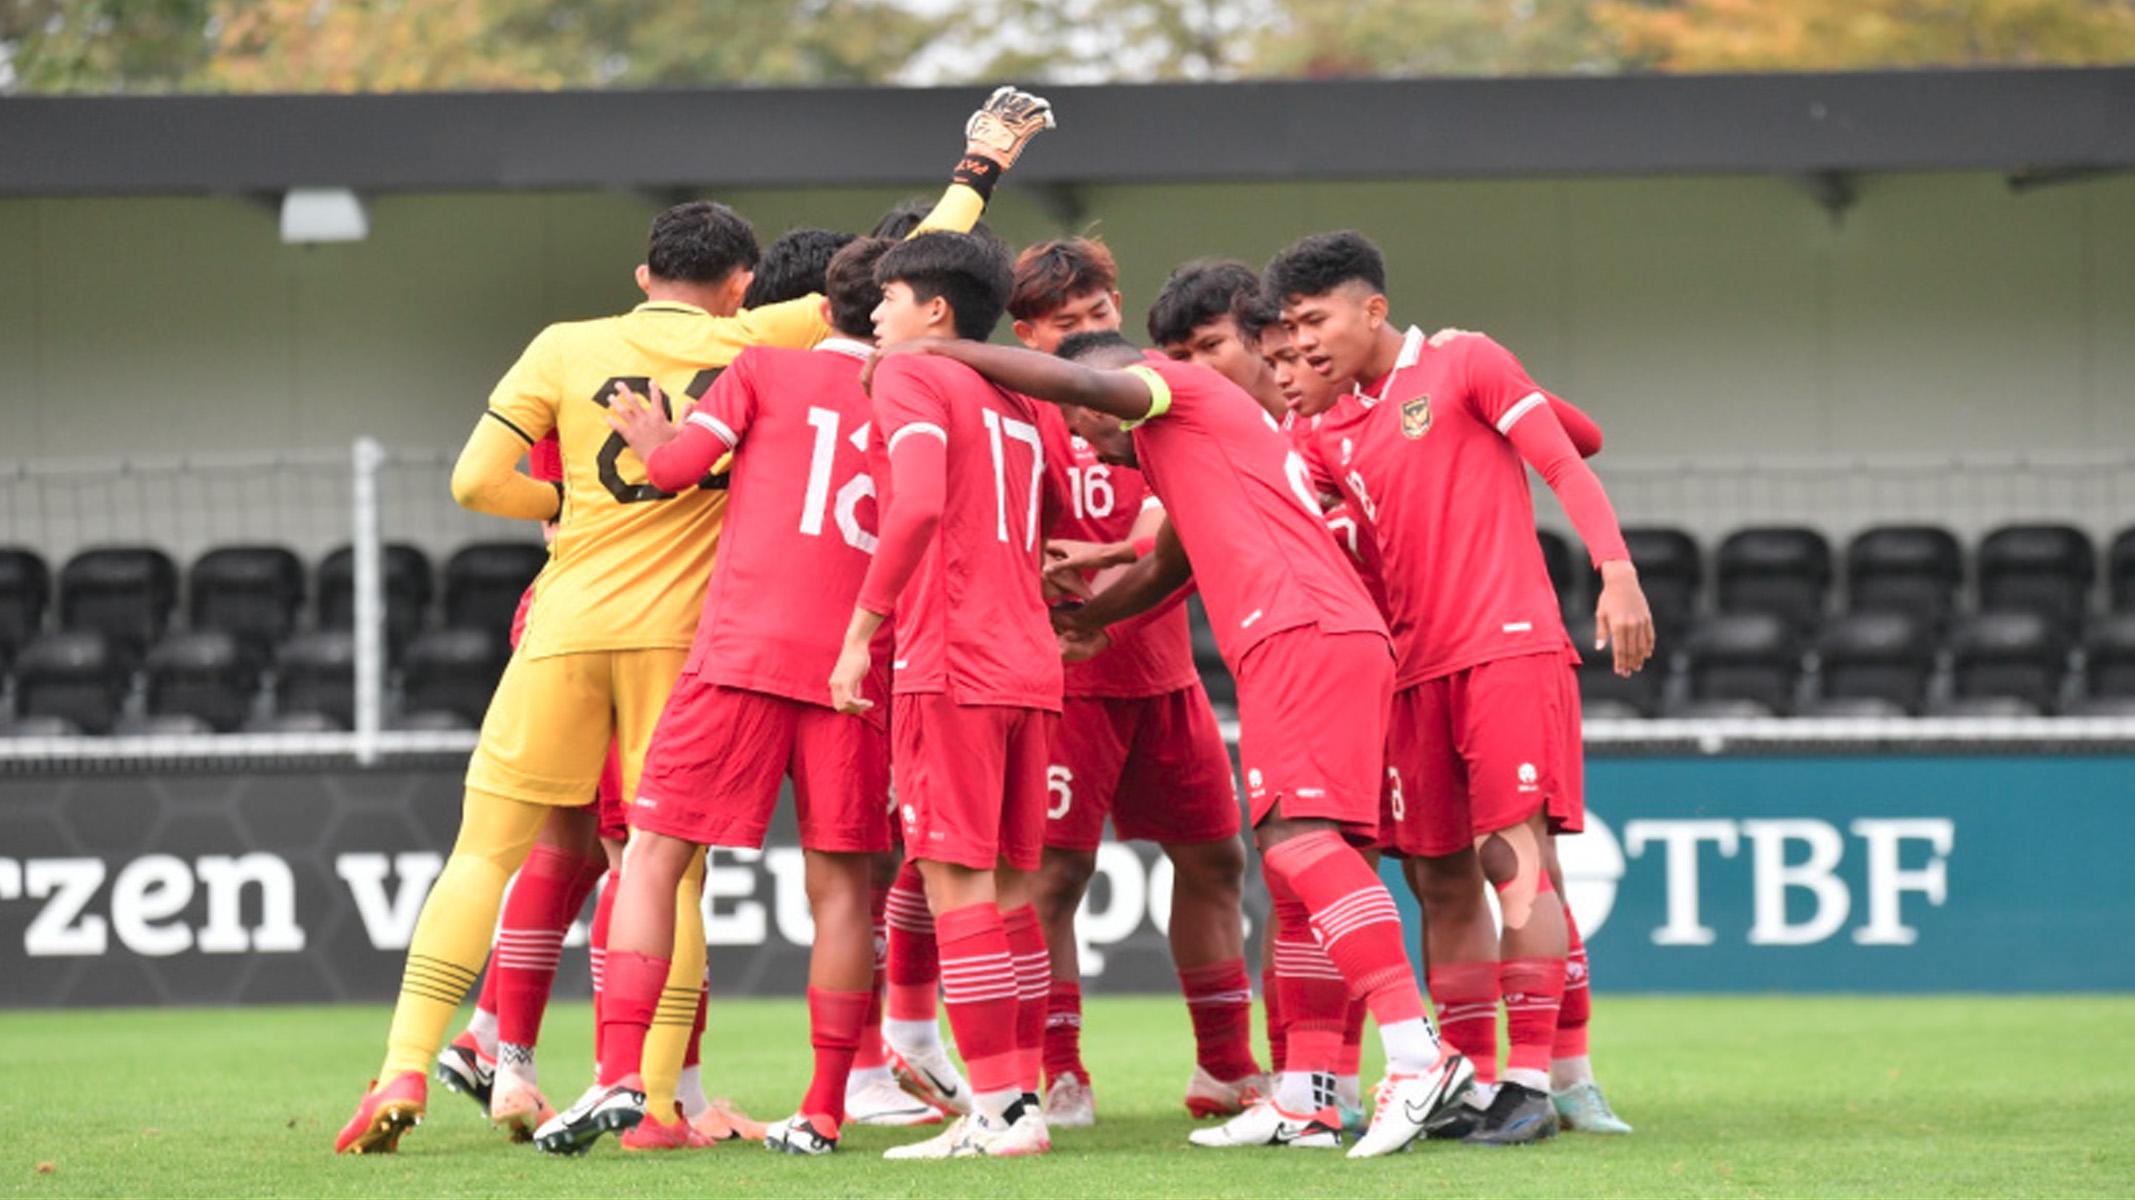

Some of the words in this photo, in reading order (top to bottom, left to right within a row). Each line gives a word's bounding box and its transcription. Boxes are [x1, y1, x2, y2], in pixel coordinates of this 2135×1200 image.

[982, 407, 1046, 553] 17
[1066, 463, 1114, 519] 16
[1624, 817, 1955, 946] TBF
